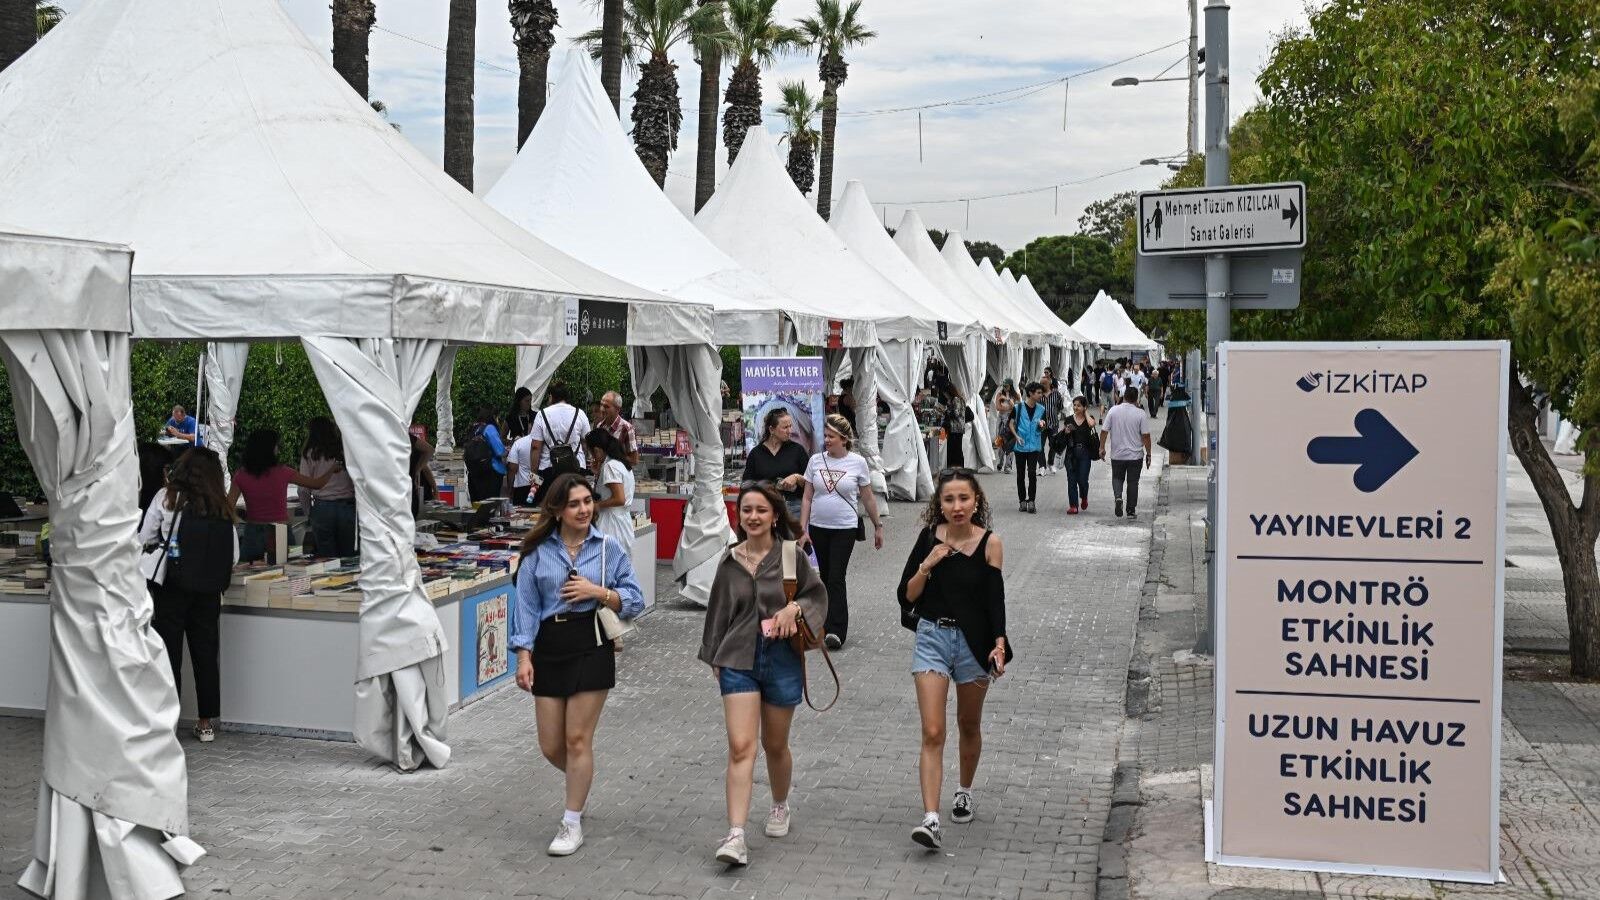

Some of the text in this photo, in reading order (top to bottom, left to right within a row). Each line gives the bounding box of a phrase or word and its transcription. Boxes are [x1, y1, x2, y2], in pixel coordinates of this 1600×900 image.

[1165, 194, 1280, 216] Mehmet Tüzüm KIZILCAN
[1190, 223, 1255, 242] Sanat Galerisi
[566, 322, 577, 337] L19
[745, 364, 819, 378] MAVİSEL YENER
[1327, 369, 1428, 393] İZKİTAP
[1249, 509, 1471, 540] YAYINEVLERİ 2
[1277, 576, 1429, 607] MONTRÖ
[1281, 612, 1434, 647] ETKİNLİK
[1285, 649, 1429, 681] SAHNESİ
[1248, 713, 1466, 747] UZUN HAVUZ
[1280, 749, 1432, 784] ETKİNLİK
[1283, 792, 1426, 823] SAHNESİ
